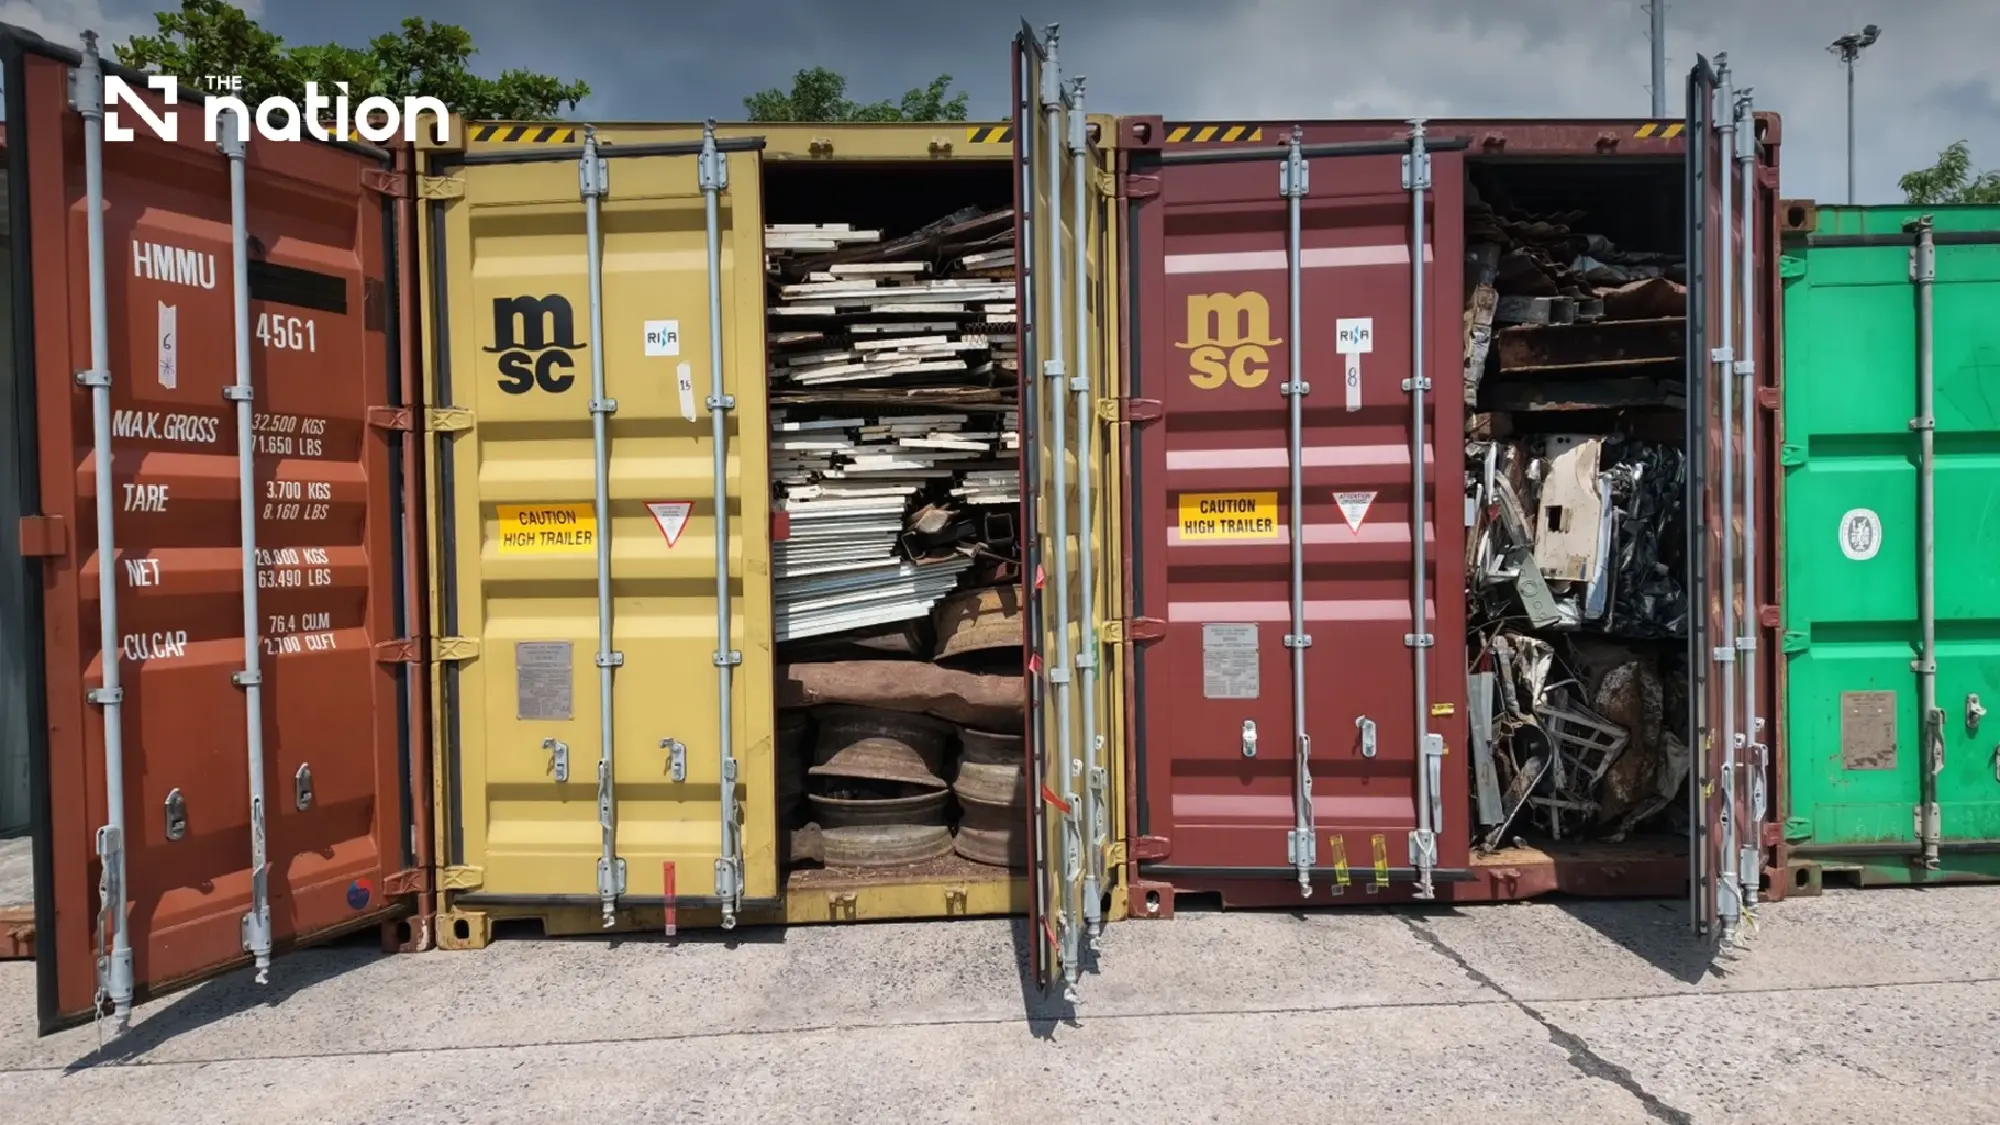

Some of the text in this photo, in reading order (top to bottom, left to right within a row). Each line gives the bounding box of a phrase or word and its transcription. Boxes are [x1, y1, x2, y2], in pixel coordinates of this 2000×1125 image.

[133, 240, 216, 290] HMMU
[163, 333, 172, 349] 6
[256, 312, 316, 352] 45G1
[112, 409, 219, 443] MAX.GROSS
[252, 413, 326, 434] 32.500 KGS
[299, 438, 322, 456] LBS
[123, 483, 169, 512] TARE
[266, 480, 331, 499] 3.700 KGS
[263, 503, 330, 520] 8.160 LBS
[1200, 498, 1257, 514] CAUTION
[518, 510, 577, 526] CAUTION
[1184, 518, 1273, 534] HIGH TRAILER
[503, 530, 593, 547] HIGH TRAILER
[302, 548, 329, 565] KGS
[124, 559, 160, 587] NET
[258, 569, 331, 588] 63.490 LBS
[269, 614, 296, 633] 76.4
[123, 630, 188, 661] CU.CAP
[264, 635, 301, 655] 2.700
